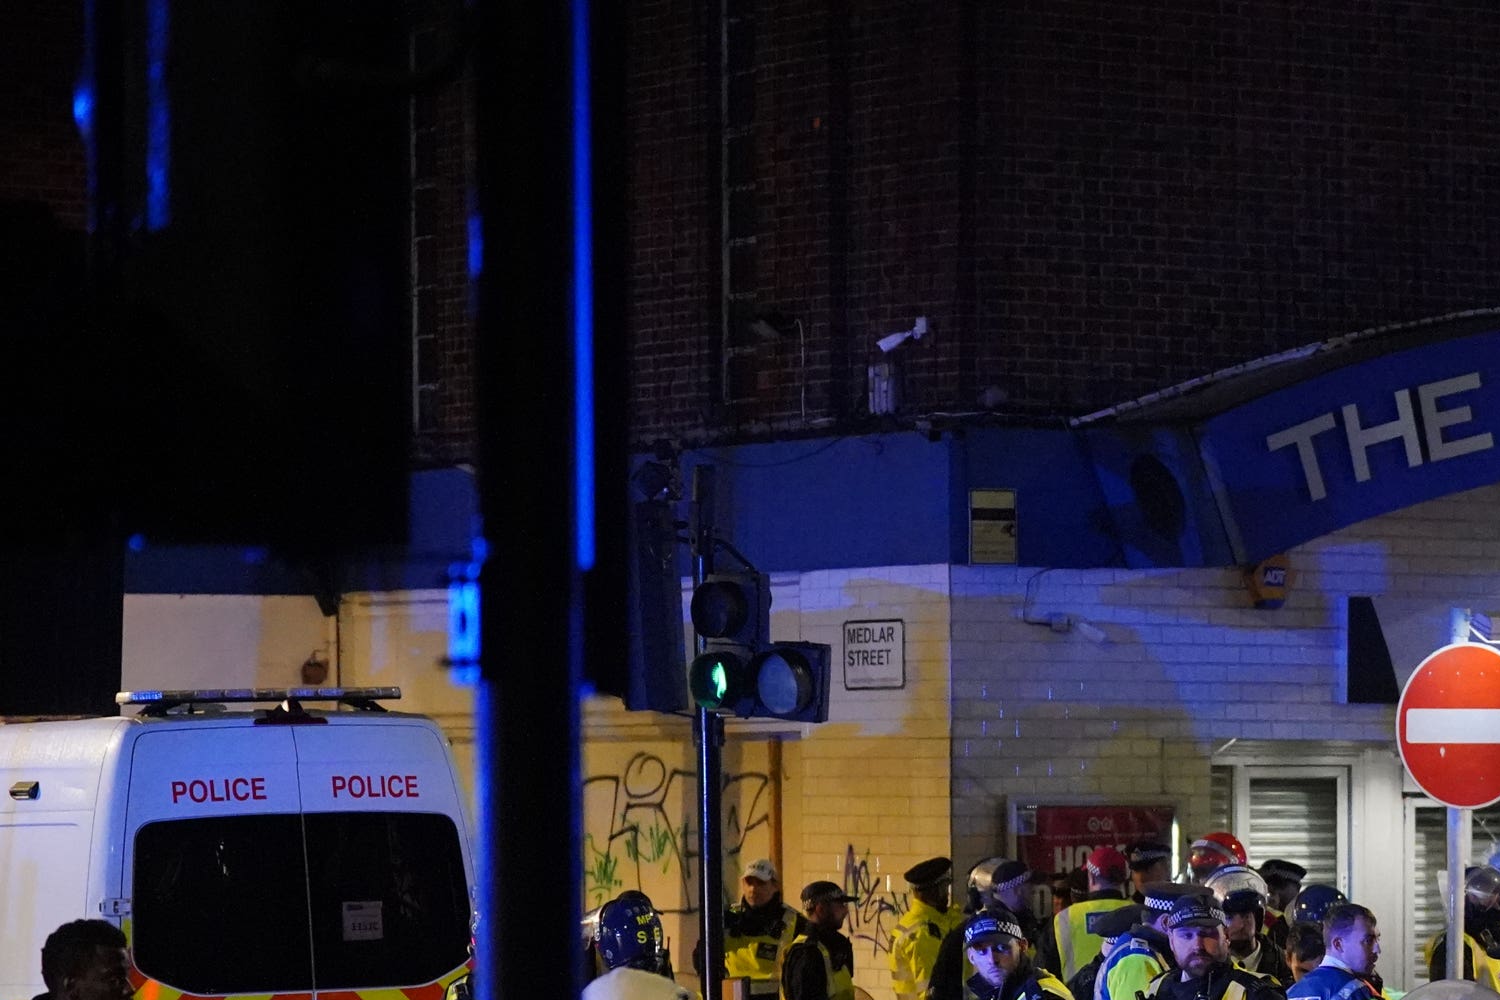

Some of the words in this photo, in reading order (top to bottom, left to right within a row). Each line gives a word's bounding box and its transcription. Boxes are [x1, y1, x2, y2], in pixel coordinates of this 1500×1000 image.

[1266, 372, 1495, 501] THE
[847, 627, 895, 644] MEDLAR
[847, 649, 891, 667] STREET
[171, 781, 267, 804] POLICE
[332, 775, 419, 798] POLICE
[636, 913, 653, 926] MP
